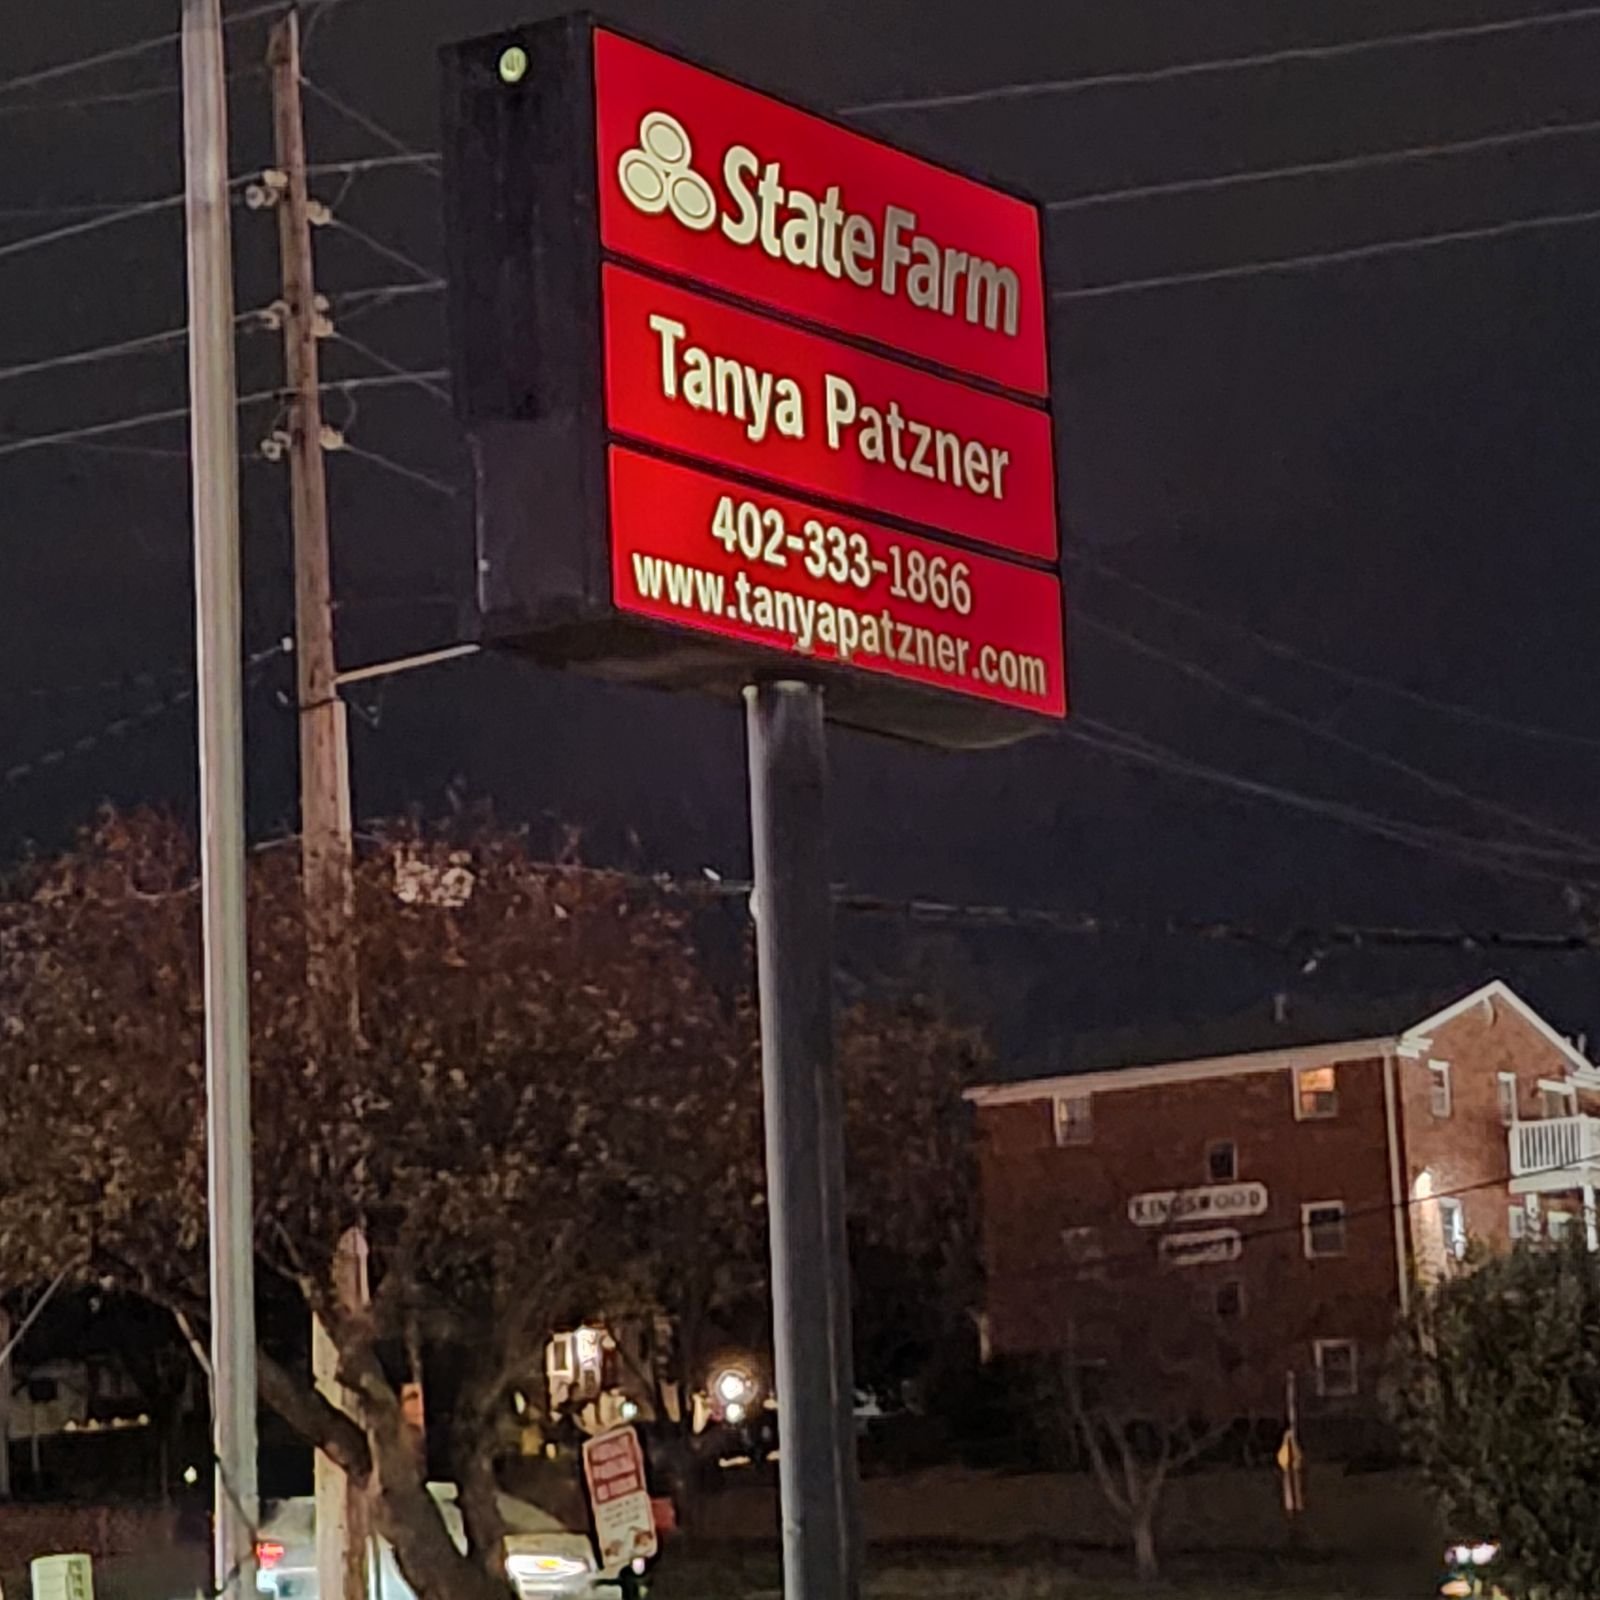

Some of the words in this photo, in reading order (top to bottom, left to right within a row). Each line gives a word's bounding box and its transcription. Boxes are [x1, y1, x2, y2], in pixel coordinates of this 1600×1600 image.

[650, 314, 805, 442] Tanya
[825, 374, 1009, 499] Patzner
[632, 552, 1047, 695] www.tanyapatzner.com
[711, 496, 971, 615] 402-333-1866
